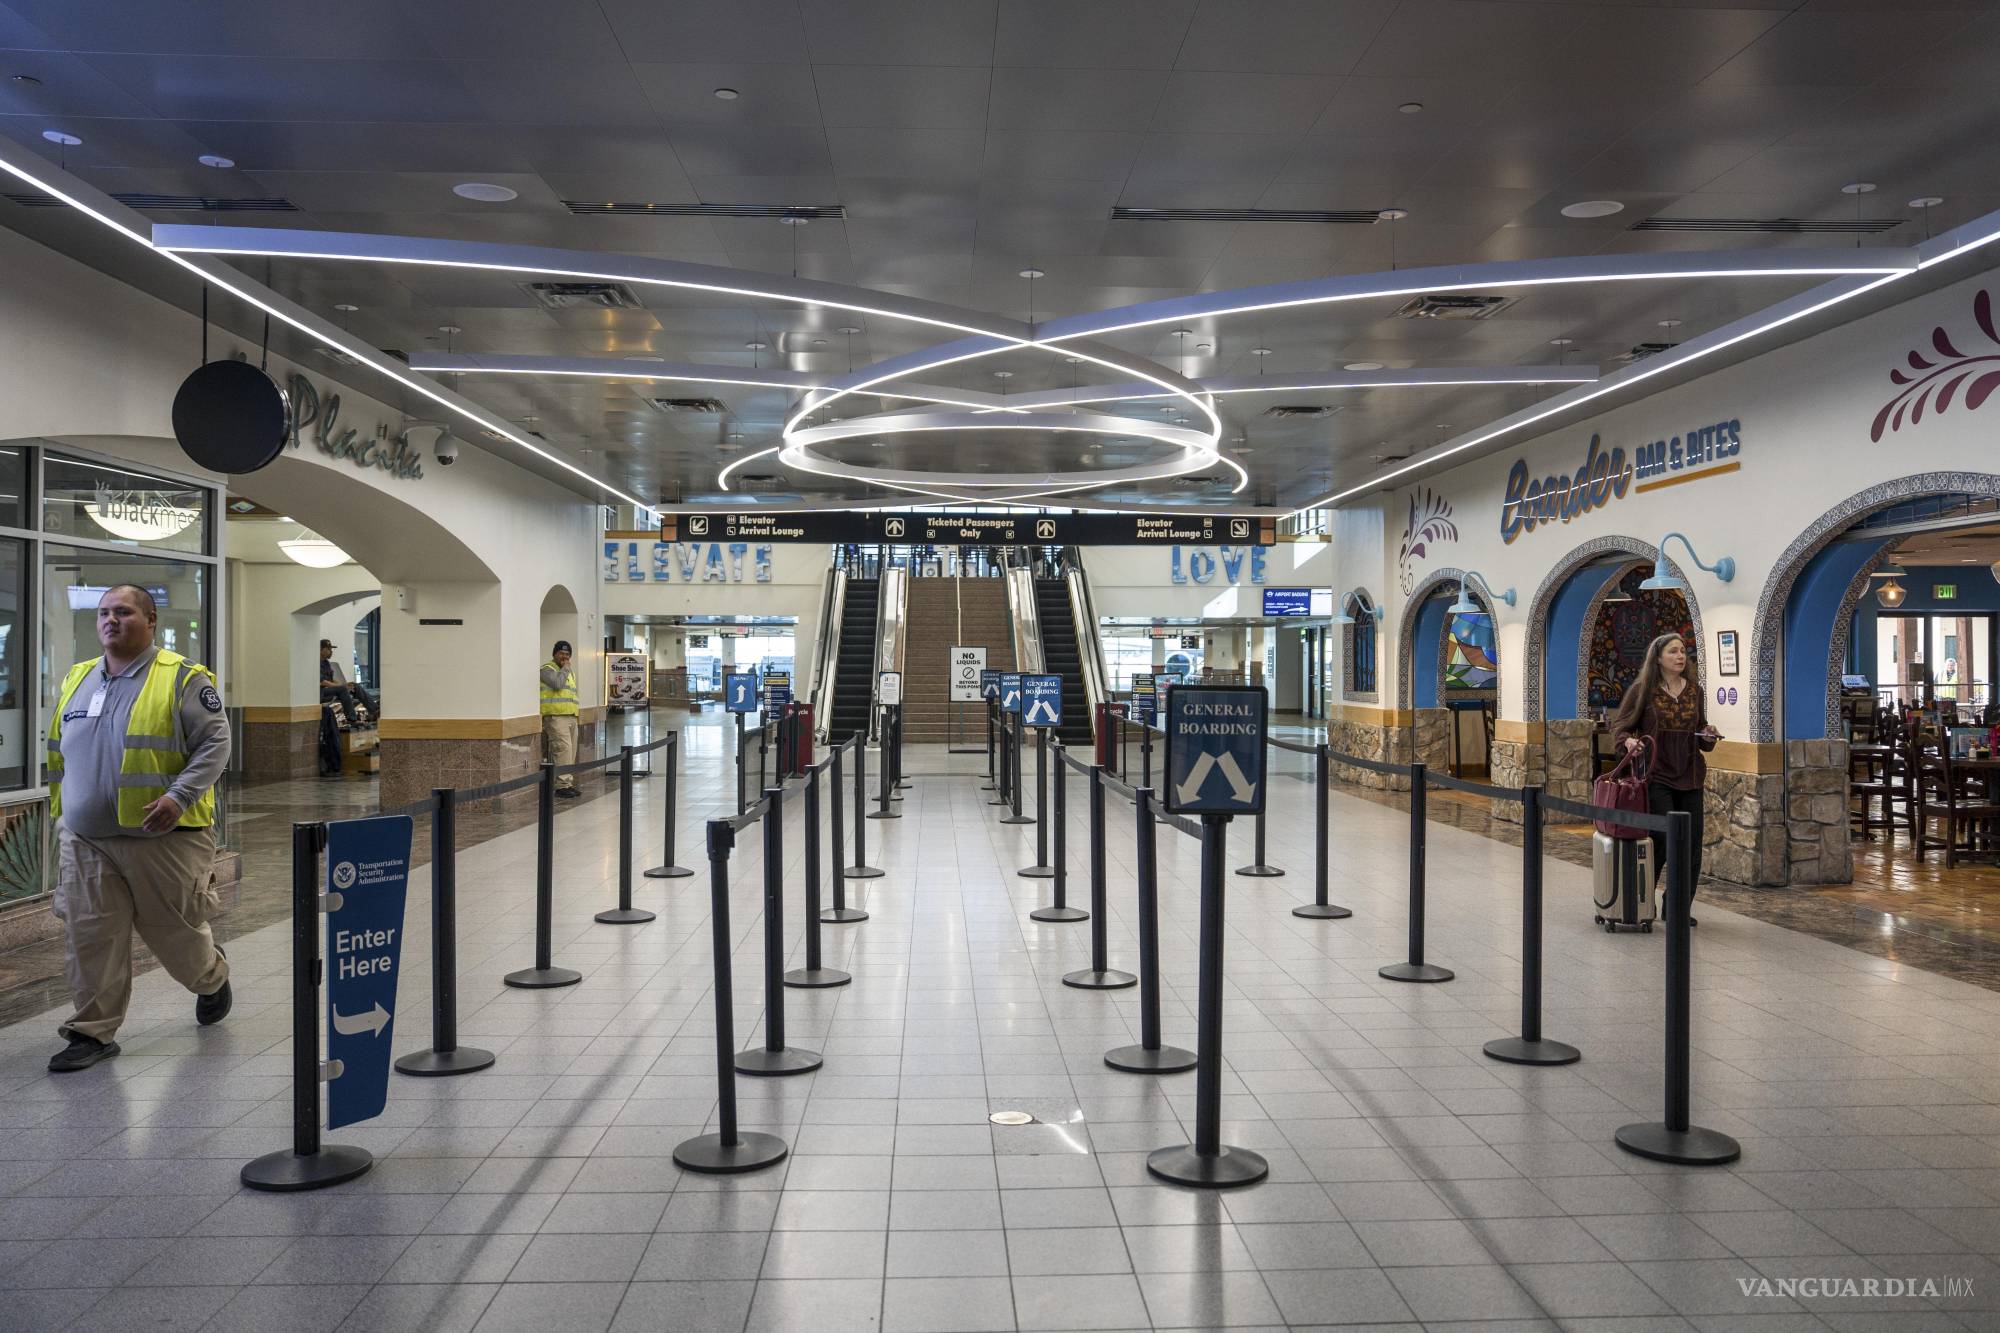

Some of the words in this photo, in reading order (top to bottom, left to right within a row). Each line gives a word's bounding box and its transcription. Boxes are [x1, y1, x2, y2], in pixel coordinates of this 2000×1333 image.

[289, 373, 424, 480] Placita
[1500, 433, 1633, 545] Boarder
[1635, 440, 1667, 480] BAR
[1669, 436, 1684, 470] &
[1686, 419, 1741, 467] BITES
[739, 516, 776, 525] Elevator
[927, 518, 963, 526] Ticketed
[966, 518, 1015, 528] Passengers
[1136, 519, 1173, 527] Elevator
[739, 526, 770, 535] Arrival
[772, 527, 804, 537] Lounge
[960, 528, 982, 539] Only
[1136, 529, 1168, 538] Arrival
[1169, 529, 1201, 540] Lounge
[604, 543, 772, 582] ELEVATE
[1171, 545, 1267, 585] LOVE
[1183, 703, 1254, 716] GENERAL
[1179, 722, 1257, 735] BOARDING
[358, 859, 404, 870] Transportation
[358, 868, 385, 878] Security
[358, 873, 405, 885] Administration
[336, 928, 396, 954] Enter
[339, 955, 392, 980] Here
